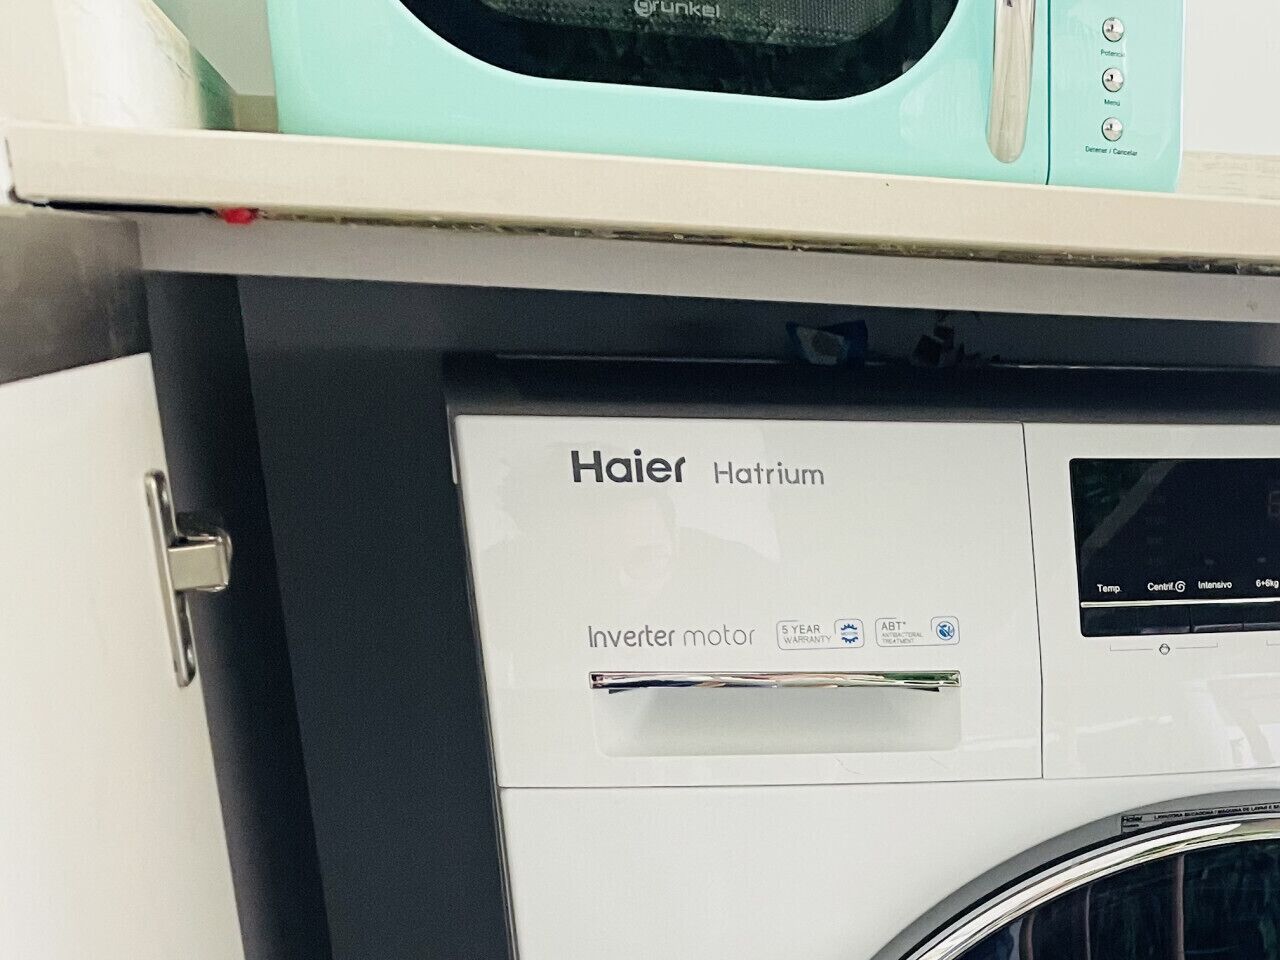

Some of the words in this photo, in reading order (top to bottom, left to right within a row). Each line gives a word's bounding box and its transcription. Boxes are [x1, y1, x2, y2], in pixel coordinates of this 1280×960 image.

[1085, 145, 1107, 154] Detener
[1113, 148, 1138, 157] Cancelar
[571, 448, 686, 483] Haier
[713, 461, 825, 485] Hatrium
[1198, 580, 1233, 589] Intensivo
[1255, 579, 1280, 589] 6+6kg
[782, 625, 788, 635] 5
[792, 624, 821, 635] YEAR
[588, 624, 675, 648] Inverter
[683, 624, 756, 647] motor
[783, 635, 832, 645] WARRANTY
